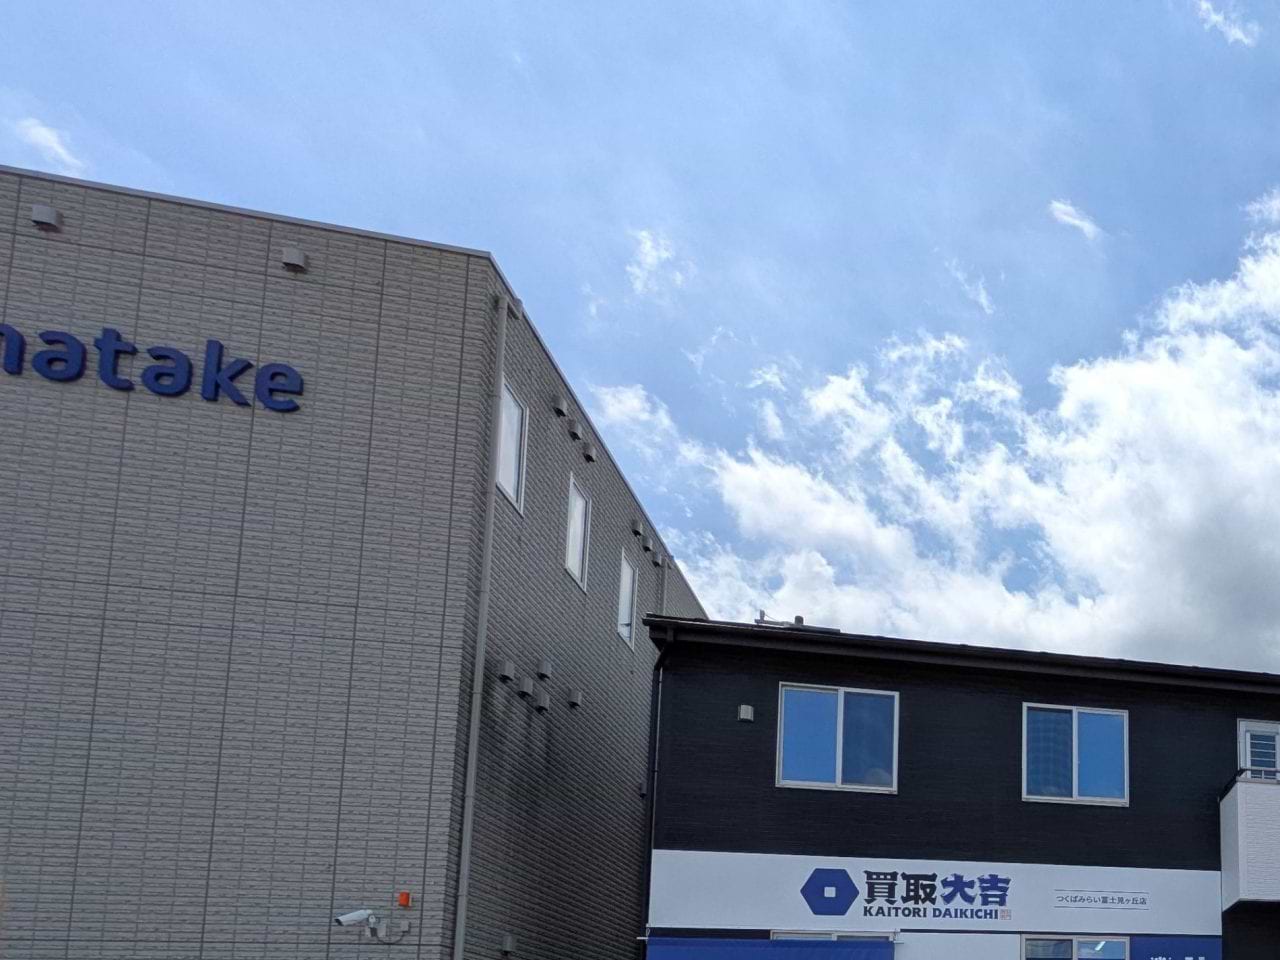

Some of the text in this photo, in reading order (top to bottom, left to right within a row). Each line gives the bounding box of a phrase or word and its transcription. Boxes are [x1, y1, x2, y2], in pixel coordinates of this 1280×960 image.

[863, 870, 1012, 906] 買取大吉
[863, 905, 927, 918] KAITORI
[932, 907, 999, 920] DAIKICHI
